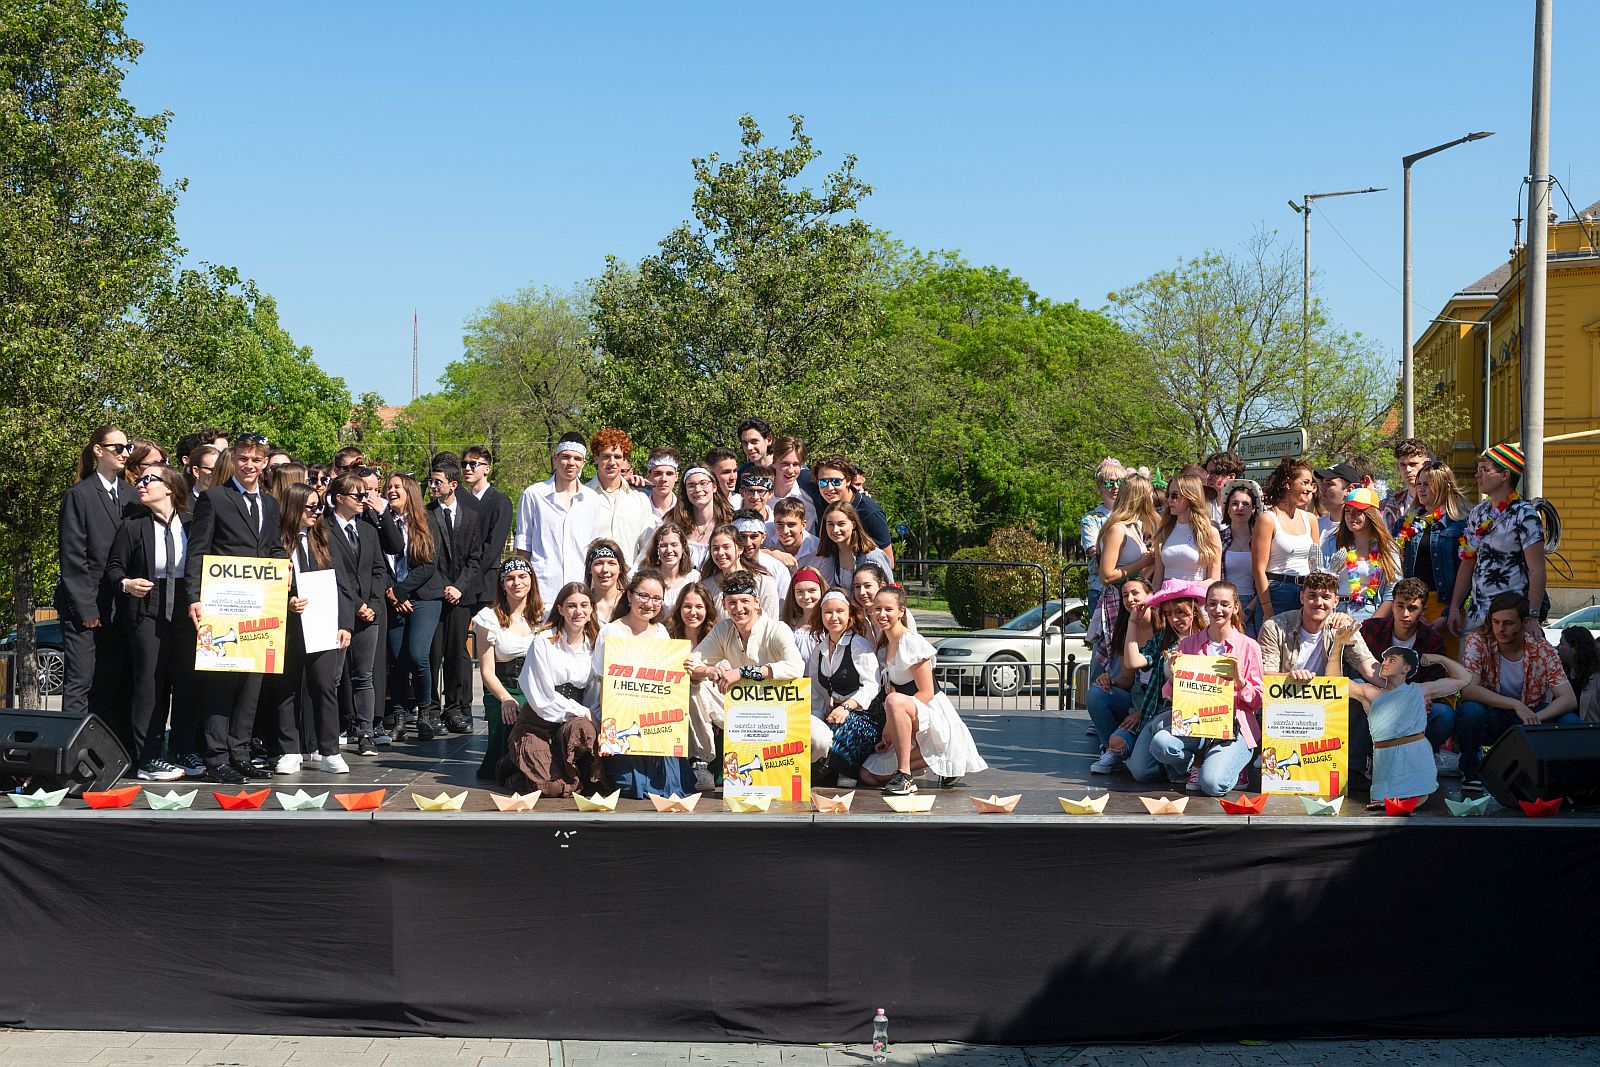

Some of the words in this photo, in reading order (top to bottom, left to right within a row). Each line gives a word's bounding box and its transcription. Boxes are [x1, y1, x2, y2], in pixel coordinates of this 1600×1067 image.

[209, 562, 282, 580] OKLEVÉL
[730, 681, 804, 702] OKLEVÉL
[1268, 680, 1342, 700] OKLEVÉL
